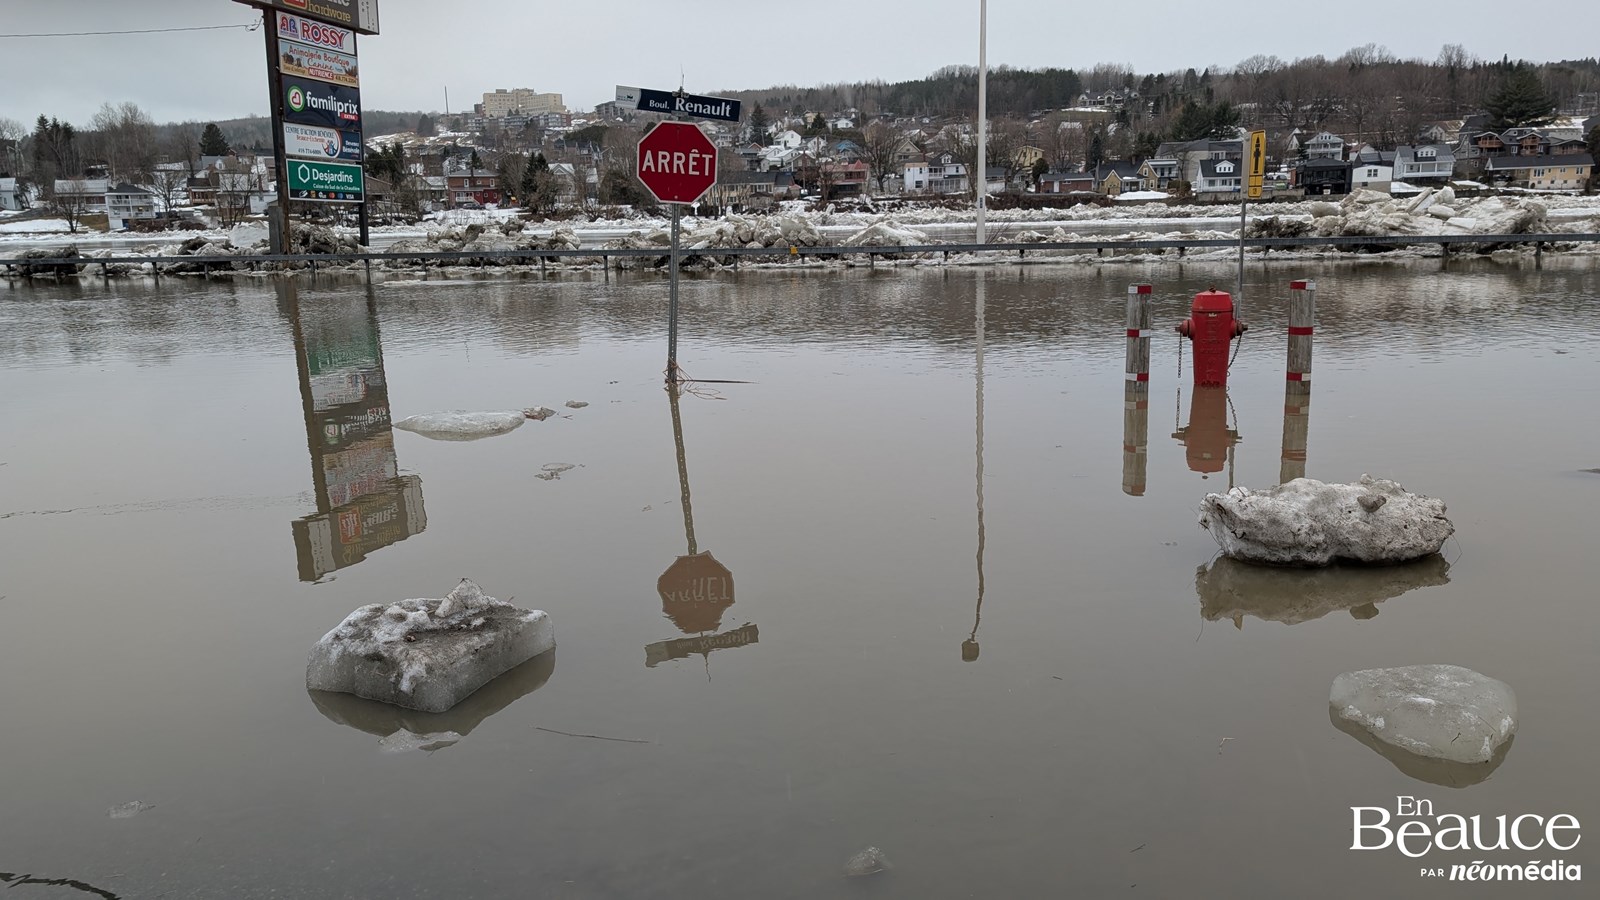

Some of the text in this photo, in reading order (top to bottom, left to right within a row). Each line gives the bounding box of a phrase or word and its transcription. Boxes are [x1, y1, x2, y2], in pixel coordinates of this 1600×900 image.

[308, 3, 351, 22] hardware
[301, 20, 347, 49] ROSSY
[289, 45, 349, 67] Animalerie Boutique
[308, 58, 334, 70] Canine
[309, 68, 333, 79] NUTRIENCE
[306, 91, 358, 117] familiprix
[649, 97, 731, 117] Boul. Renault
[642, 148, 713, 177] ARRÊT
[312, 168, 353, 184] Desjardins
